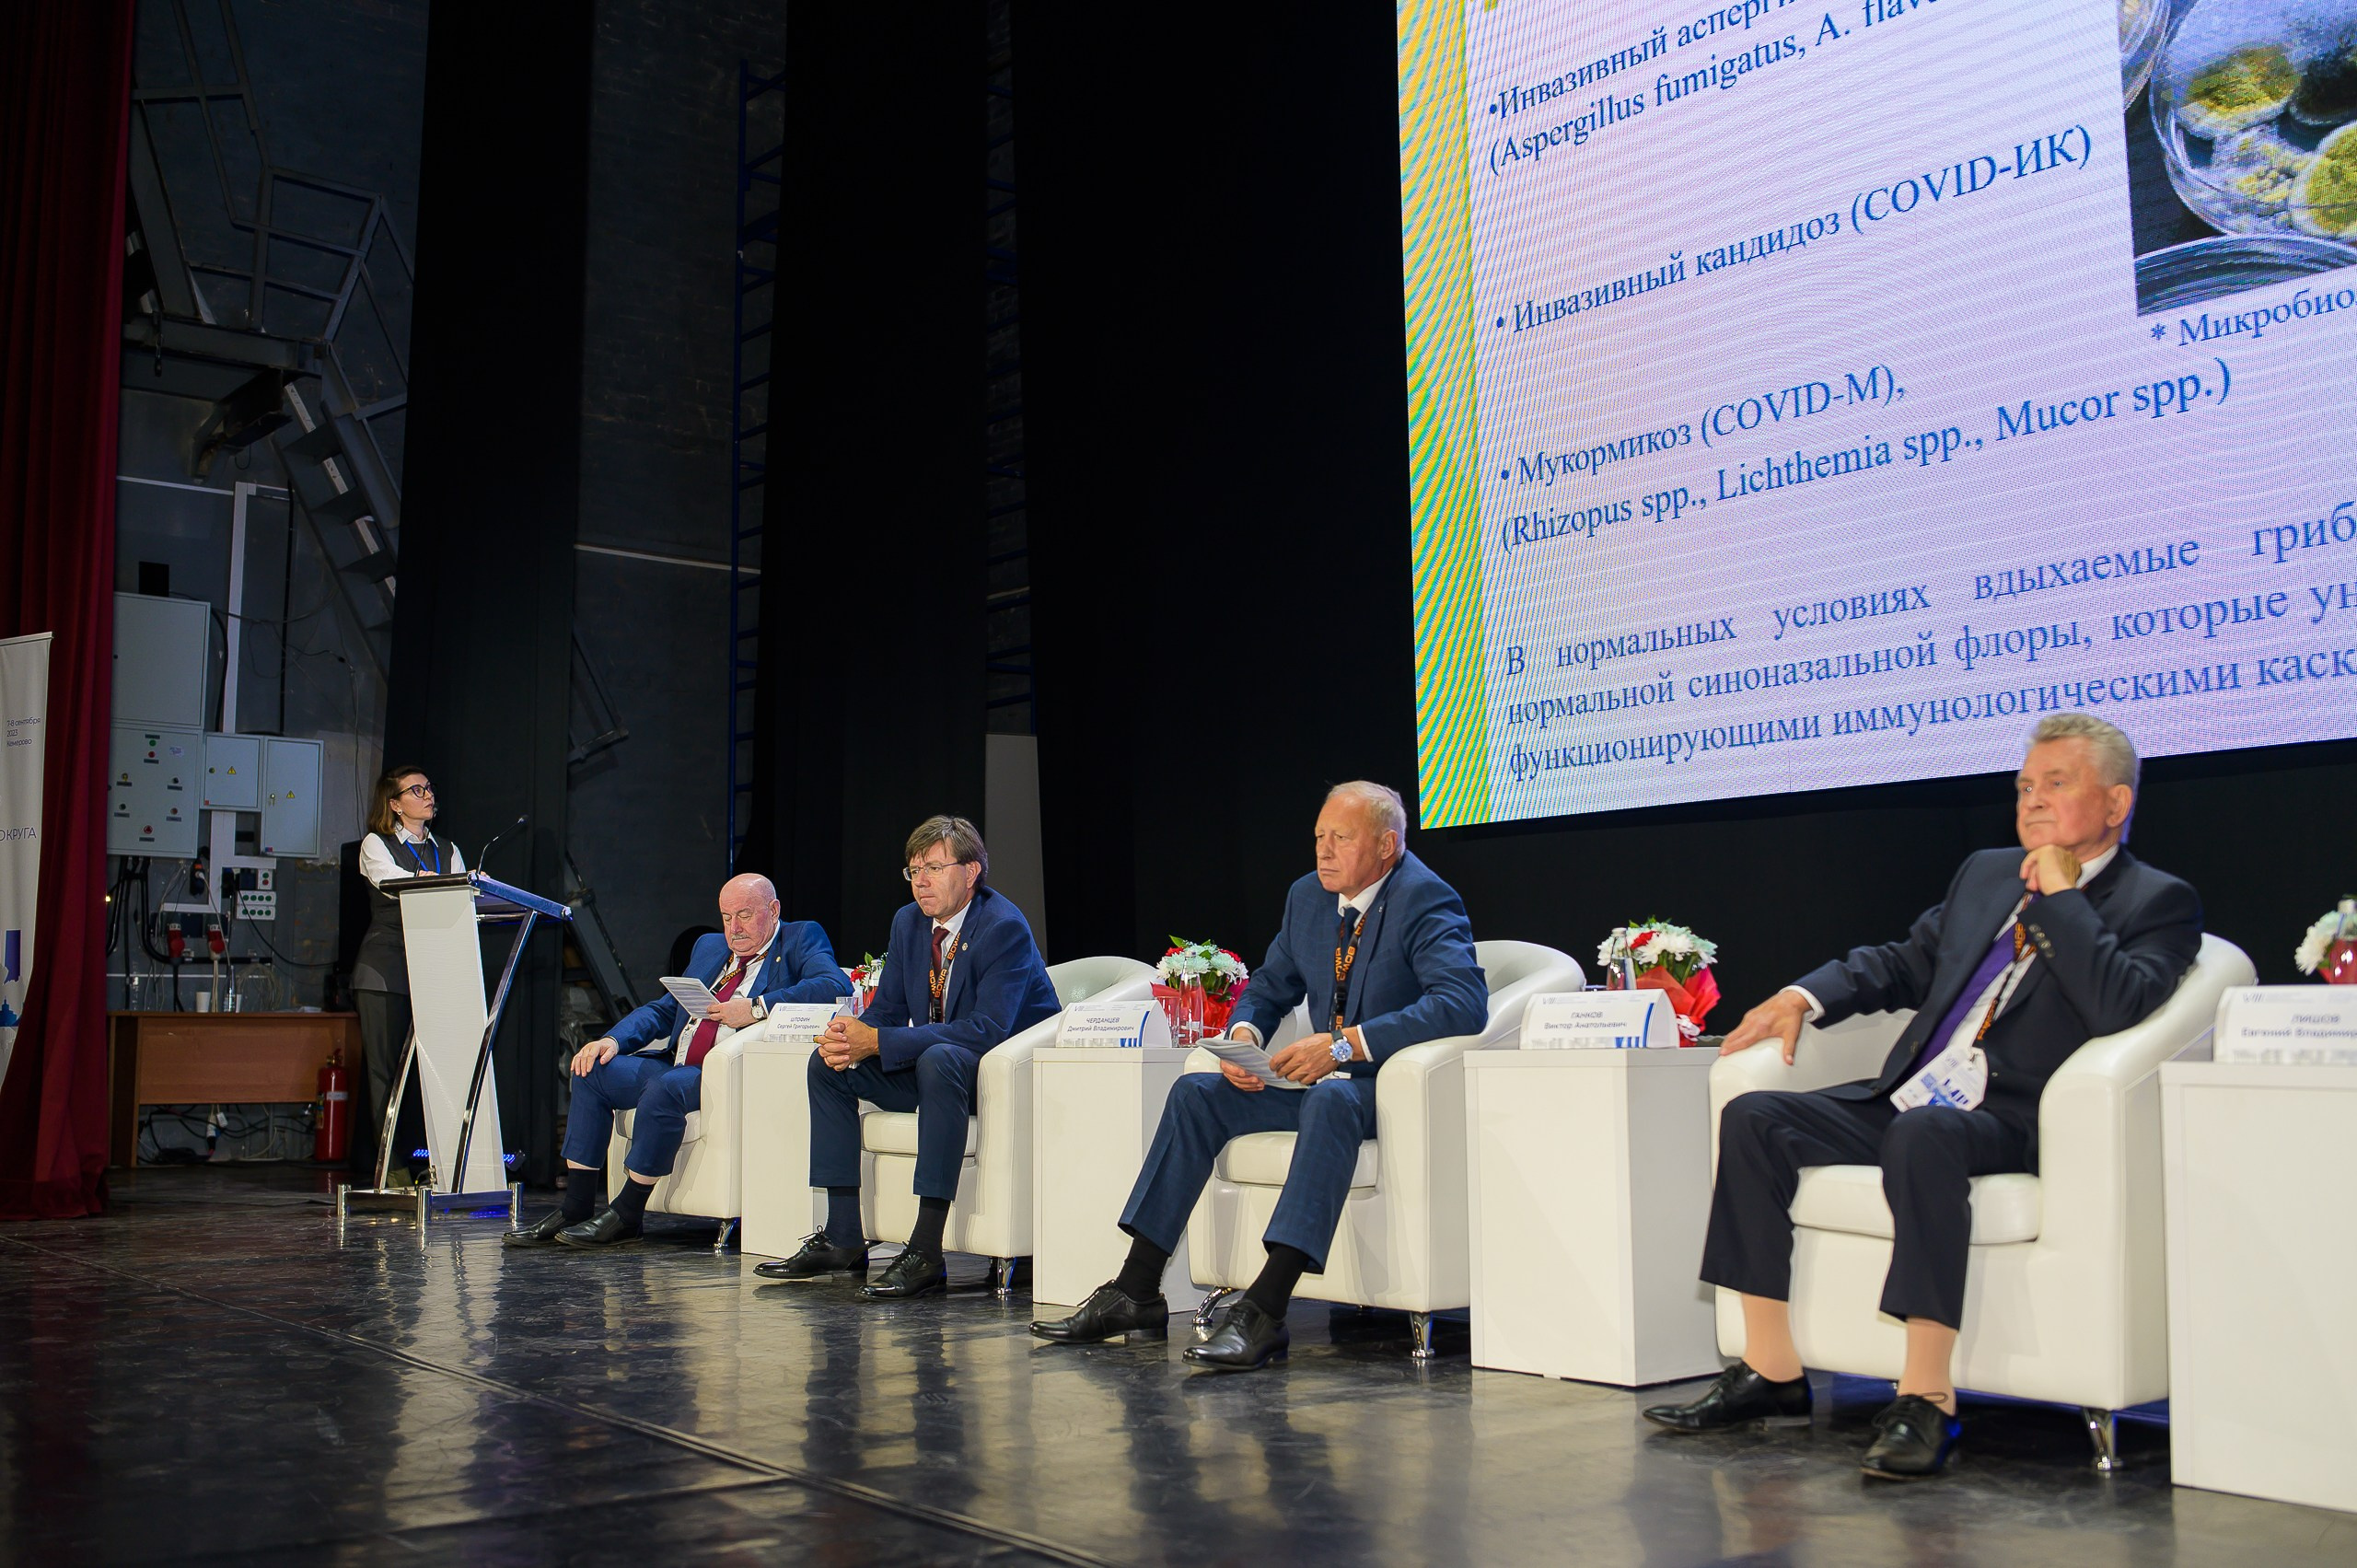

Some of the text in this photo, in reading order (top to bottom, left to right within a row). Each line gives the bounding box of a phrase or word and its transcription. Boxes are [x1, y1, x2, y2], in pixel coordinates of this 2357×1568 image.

[1490, 91, 1645, 176] (Aspergillus
[1655, 35, 1806, 106] fumigatus,
[1816, 13, 1851, 46] A.
[1499, 26, 1667, 120] Инвазивный
[1514, 124, 2092, 332] Инвазивный кандидоз (COVID-ИК)
[2178, 287, 2357, 347] Микробио
[1503, 357, 2232, 554] (Rhizopus spp., Lichthemia spp., Mucor spp.)
[1519, 364, 1905, 488] Мукормикоз (COVID-М),
[1507, 645, 1525, 675] В
[1556, 617, 1737, 671] нормальных
[1772, 584, 1932, 641] условиях
[1974, 539, 2200, 601] вдыхаемые
[1507, 671, 1675, 728] нормальной
[1689, 630, 1936, 700] синоназальной
[1956, 620, 2092, 670] флоры,
[2112, 589, 2289, 640] которые
[6, 729, 18, 738] 2023
[6, 738, 32, 748] Кемерово
[1510, 712, 1821, 781] функционирующими
[1833, 662, 2241, 737] иммунологическими
